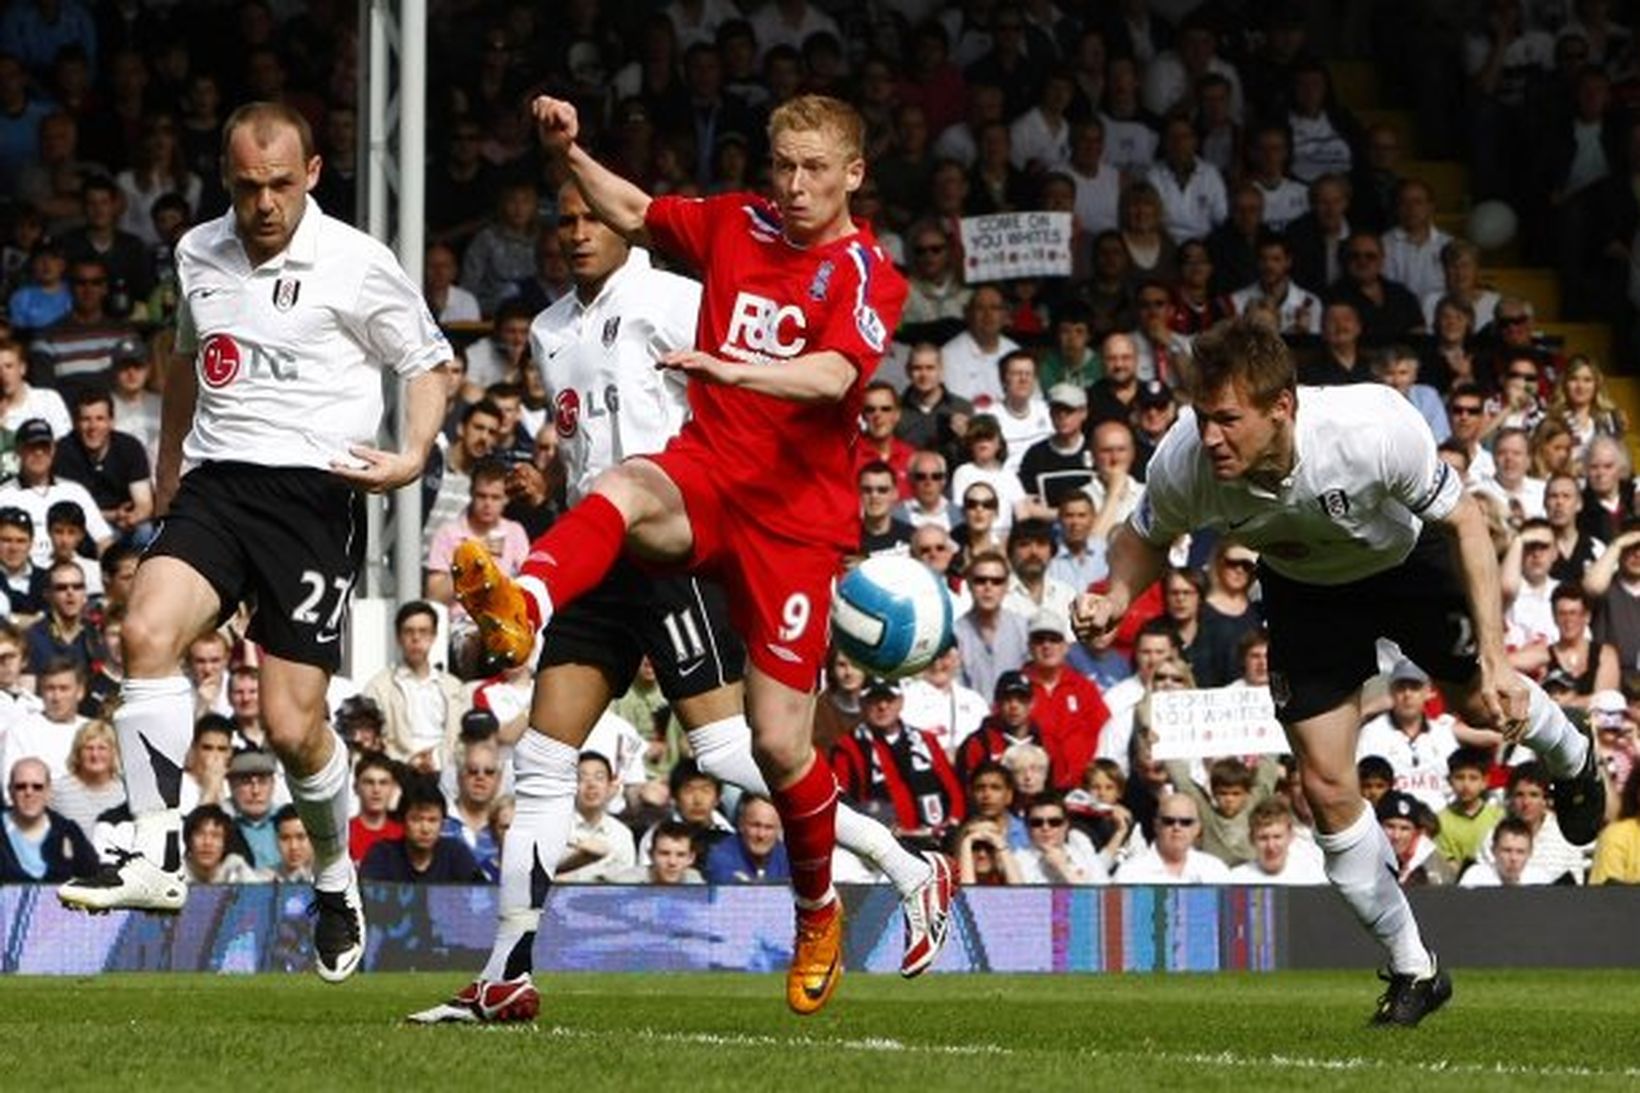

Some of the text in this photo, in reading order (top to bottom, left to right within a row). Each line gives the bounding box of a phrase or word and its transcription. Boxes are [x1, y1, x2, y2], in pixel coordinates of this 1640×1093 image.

[971, 229, 1061, 249] YOU WHITES
[977, 214, 1050, 232] COME ON
[250, 345, 298, 381] LG
[587, 384, 619, 418] LG
[292, 570, 355, 629] 27
[778, 592, 811, 642] 9
[663, 608, 705, 663] 11
